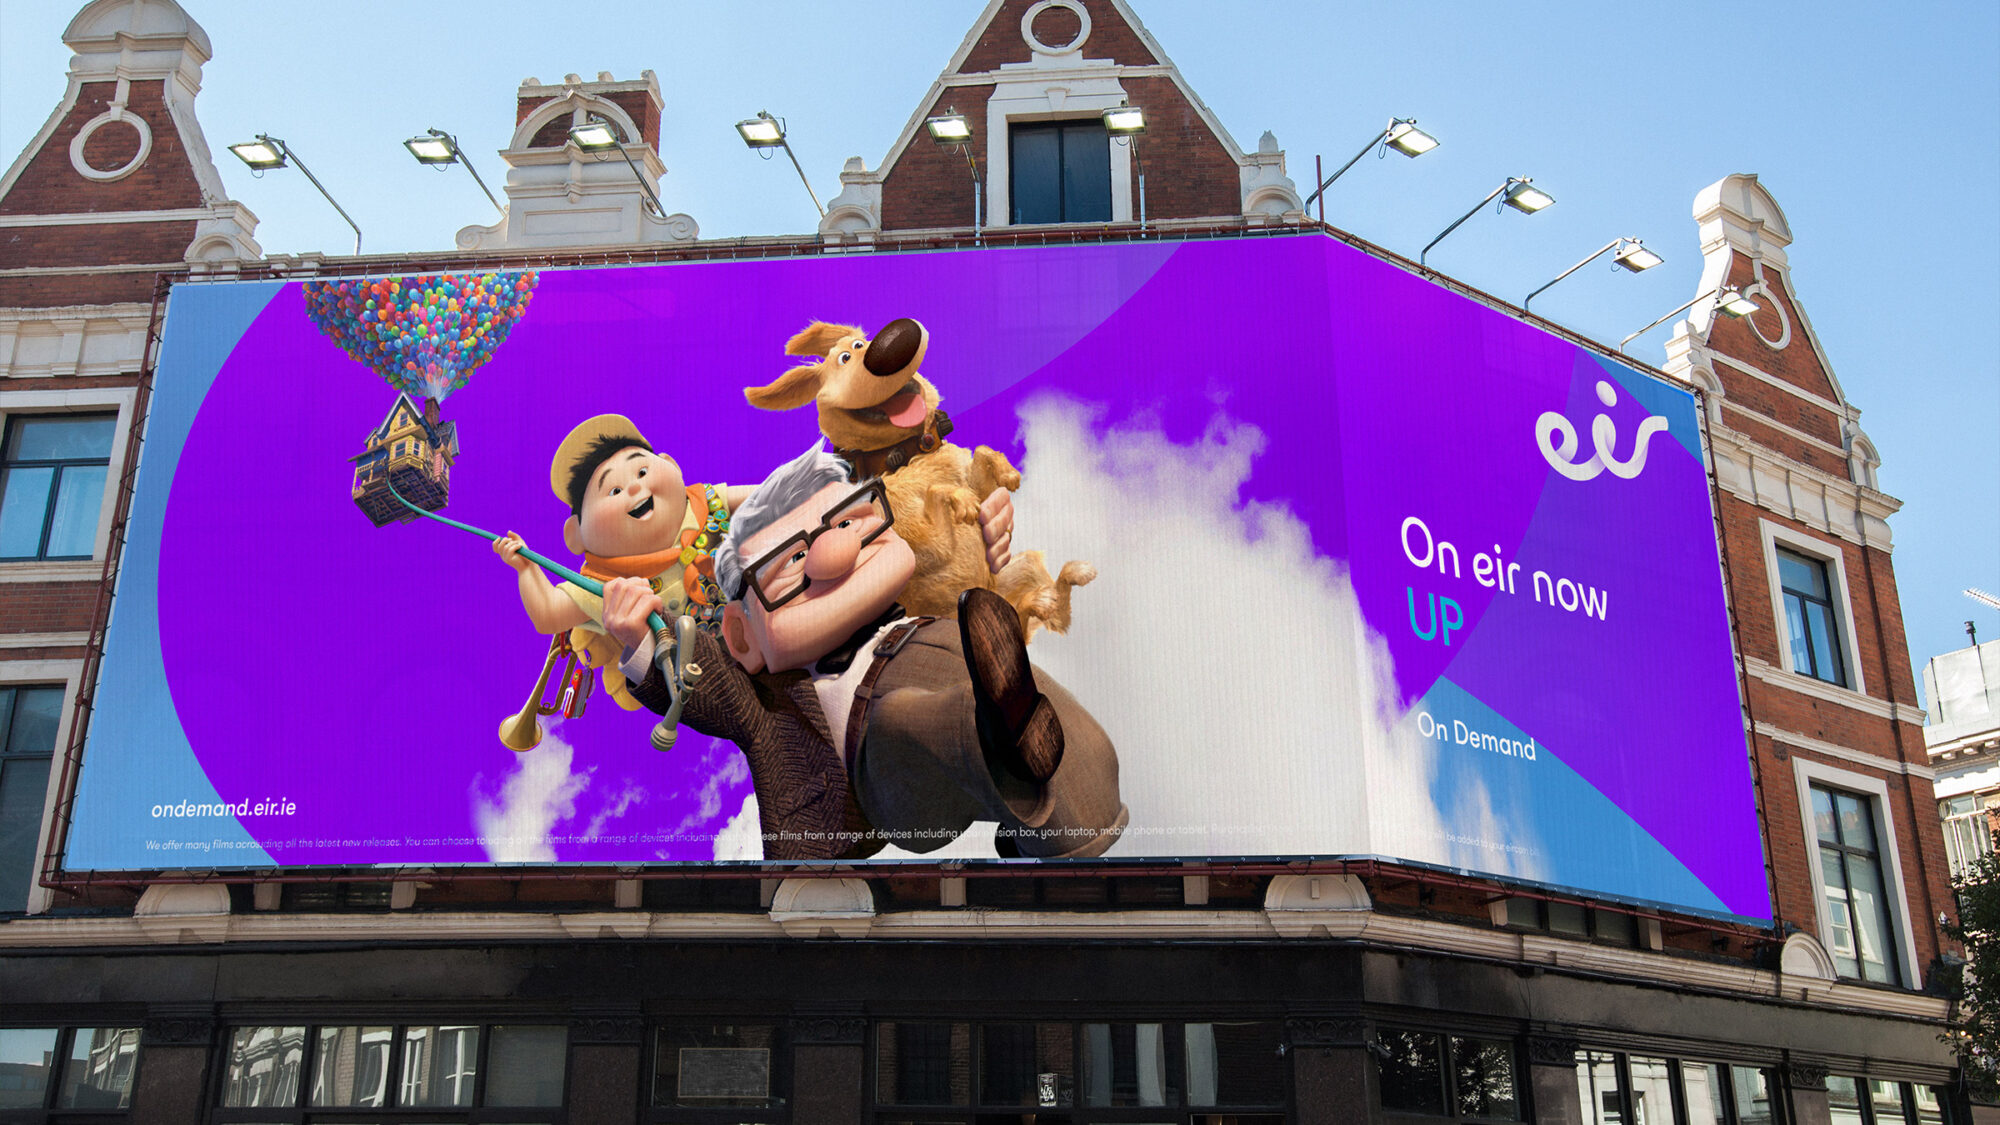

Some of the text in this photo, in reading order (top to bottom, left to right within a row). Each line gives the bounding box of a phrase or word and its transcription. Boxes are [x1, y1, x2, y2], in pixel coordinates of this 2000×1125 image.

[1535, 380, 1669, 481] eir
[1401, 516, 1608, 621] On eir now
[1406, 586, 1464, 647] UP
[1417, 711, 1537, 761] On Demand
[151, 797, 297, 818] ondemand.eir.ie
[145, 839, 160, 850] We
[162, 839, 183, 850] offer
[185, 840, 211, 852] many
[213, 838, 233, 849] films
[285, 838, 297, 849] all
[299, 837, 313, 848] the
[315, 836, 341, 848] latest
[342, 838, 361, 848] new
[405, 835, 421, 847] You
[423, 837, 440, 847] can
[442, 835, 475, 847] choose
[568, 832, 590, 844] from
[591, 834, 598, 845] a
[600, 834, 627, 847] range
[629, 831, 640, 844] of
[640, 832, 675, 844] devices
[780, 829, 802, 841] films
[804, 829, 826, 841] from
[827, 831, 834, 840] a
[836, 830, 864, 843] range
[866, 828, 876, 840] of
[877, 827, 913, 840] devices
[914, 827, 958, 842] including
[1020, 826, 1039, 839] box,
[1041, 828, 1062, 841] your
[1064, 826, 1098, 841] laptop,
[1100, 825, 1131, 837] mobile
[1134, 824, 1165, 838] phone
